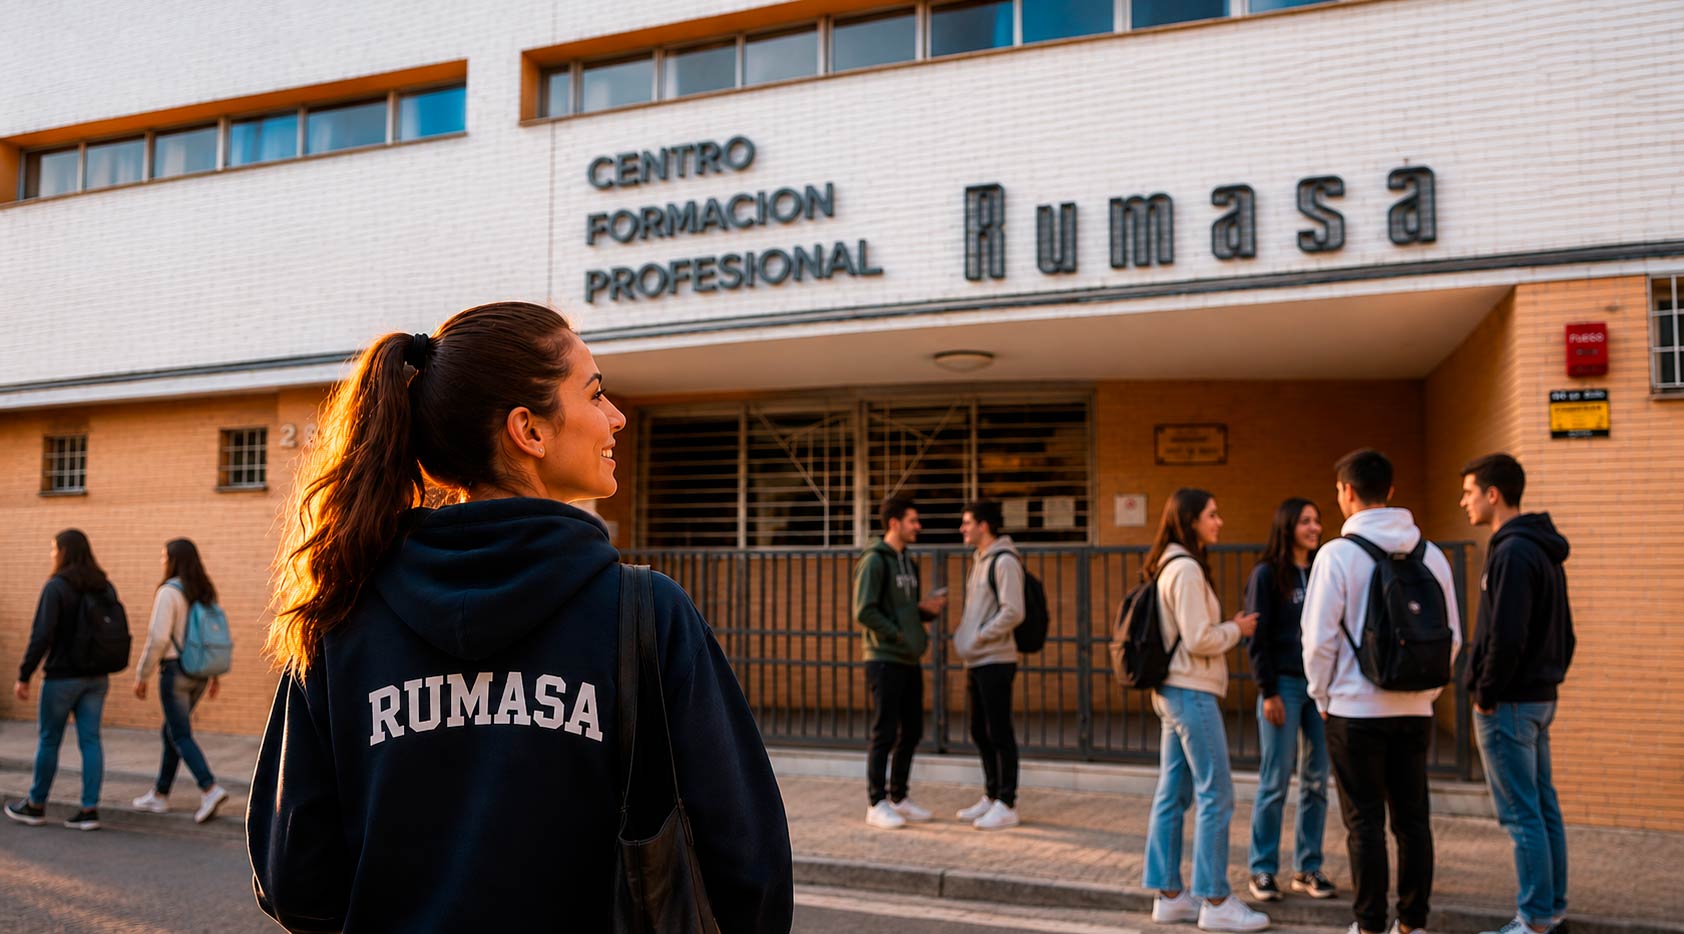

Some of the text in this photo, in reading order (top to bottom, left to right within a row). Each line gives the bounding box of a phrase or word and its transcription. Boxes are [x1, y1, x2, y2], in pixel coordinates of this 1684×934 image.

[587, 135, 756, 190] CENTRO
[586, 182, 835, 245] FORMACION
[965, 166, 1437, 281] Rumasa
[586, 239, 884, 303] PROFESIONAL
[369, 672, 602, 746] RUMASA
